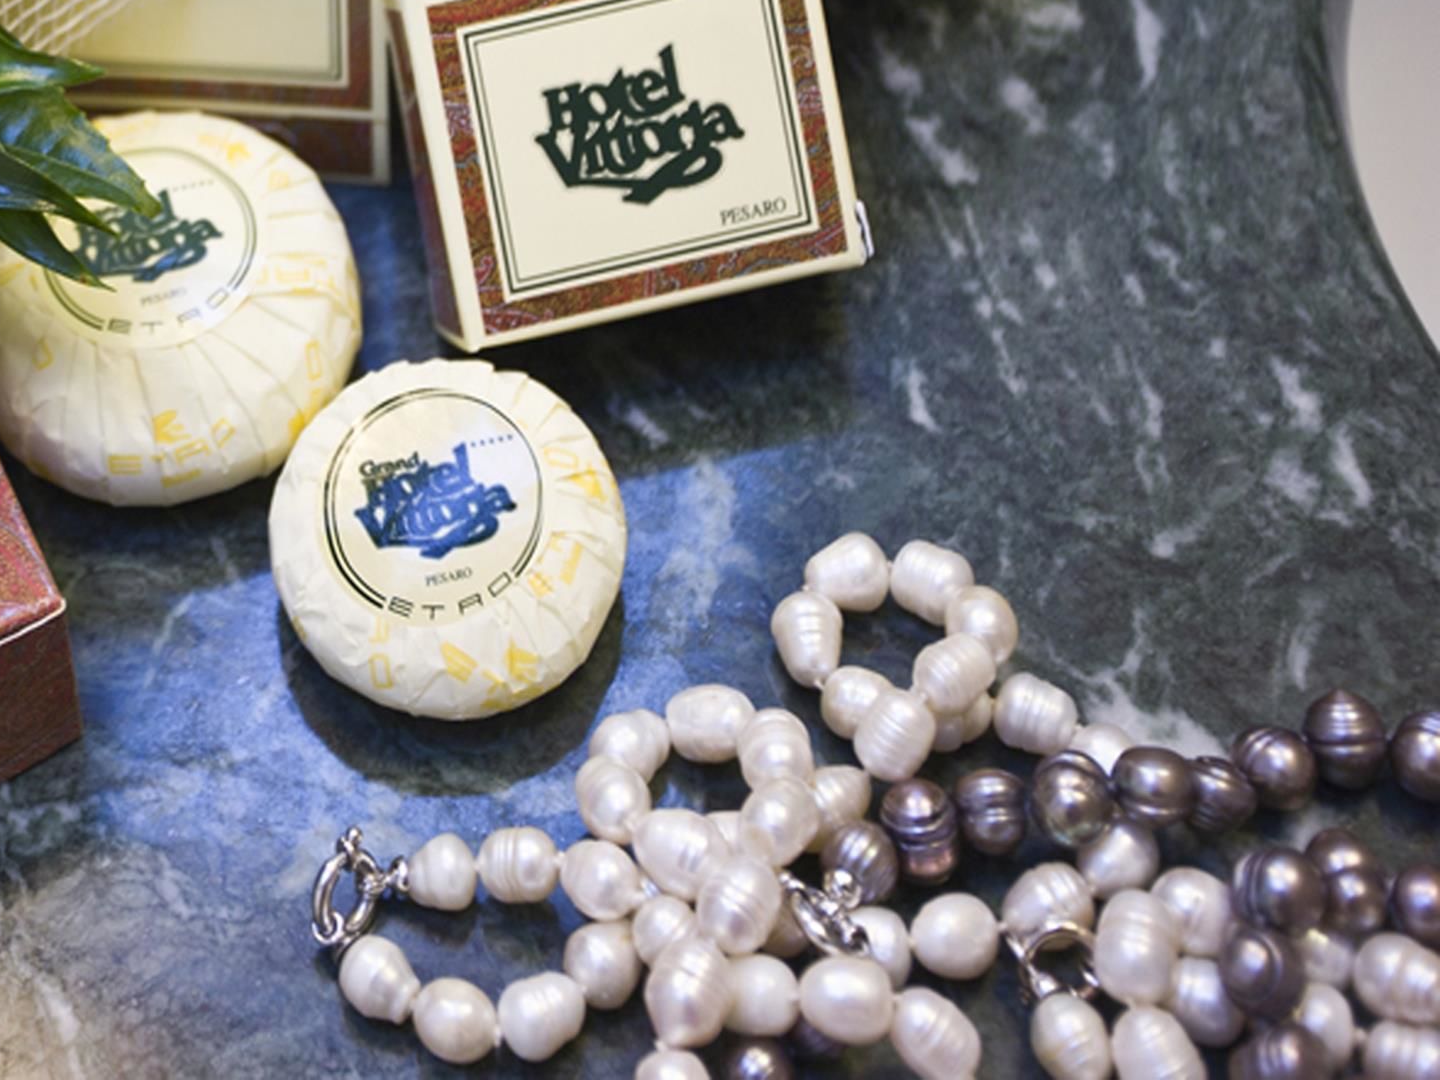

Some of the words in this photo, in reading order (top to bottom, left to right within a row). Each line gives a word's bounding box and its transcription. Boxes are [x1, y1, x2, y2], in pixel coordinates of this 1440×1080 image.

[541, 42, 687, 132] Hotel
[720, 196, 787, 226] PESARO
[359, 450, 422, 479] Grand
[424, 566, 474, 588] PESARO
[387, 571, 513, 621] ETRO
